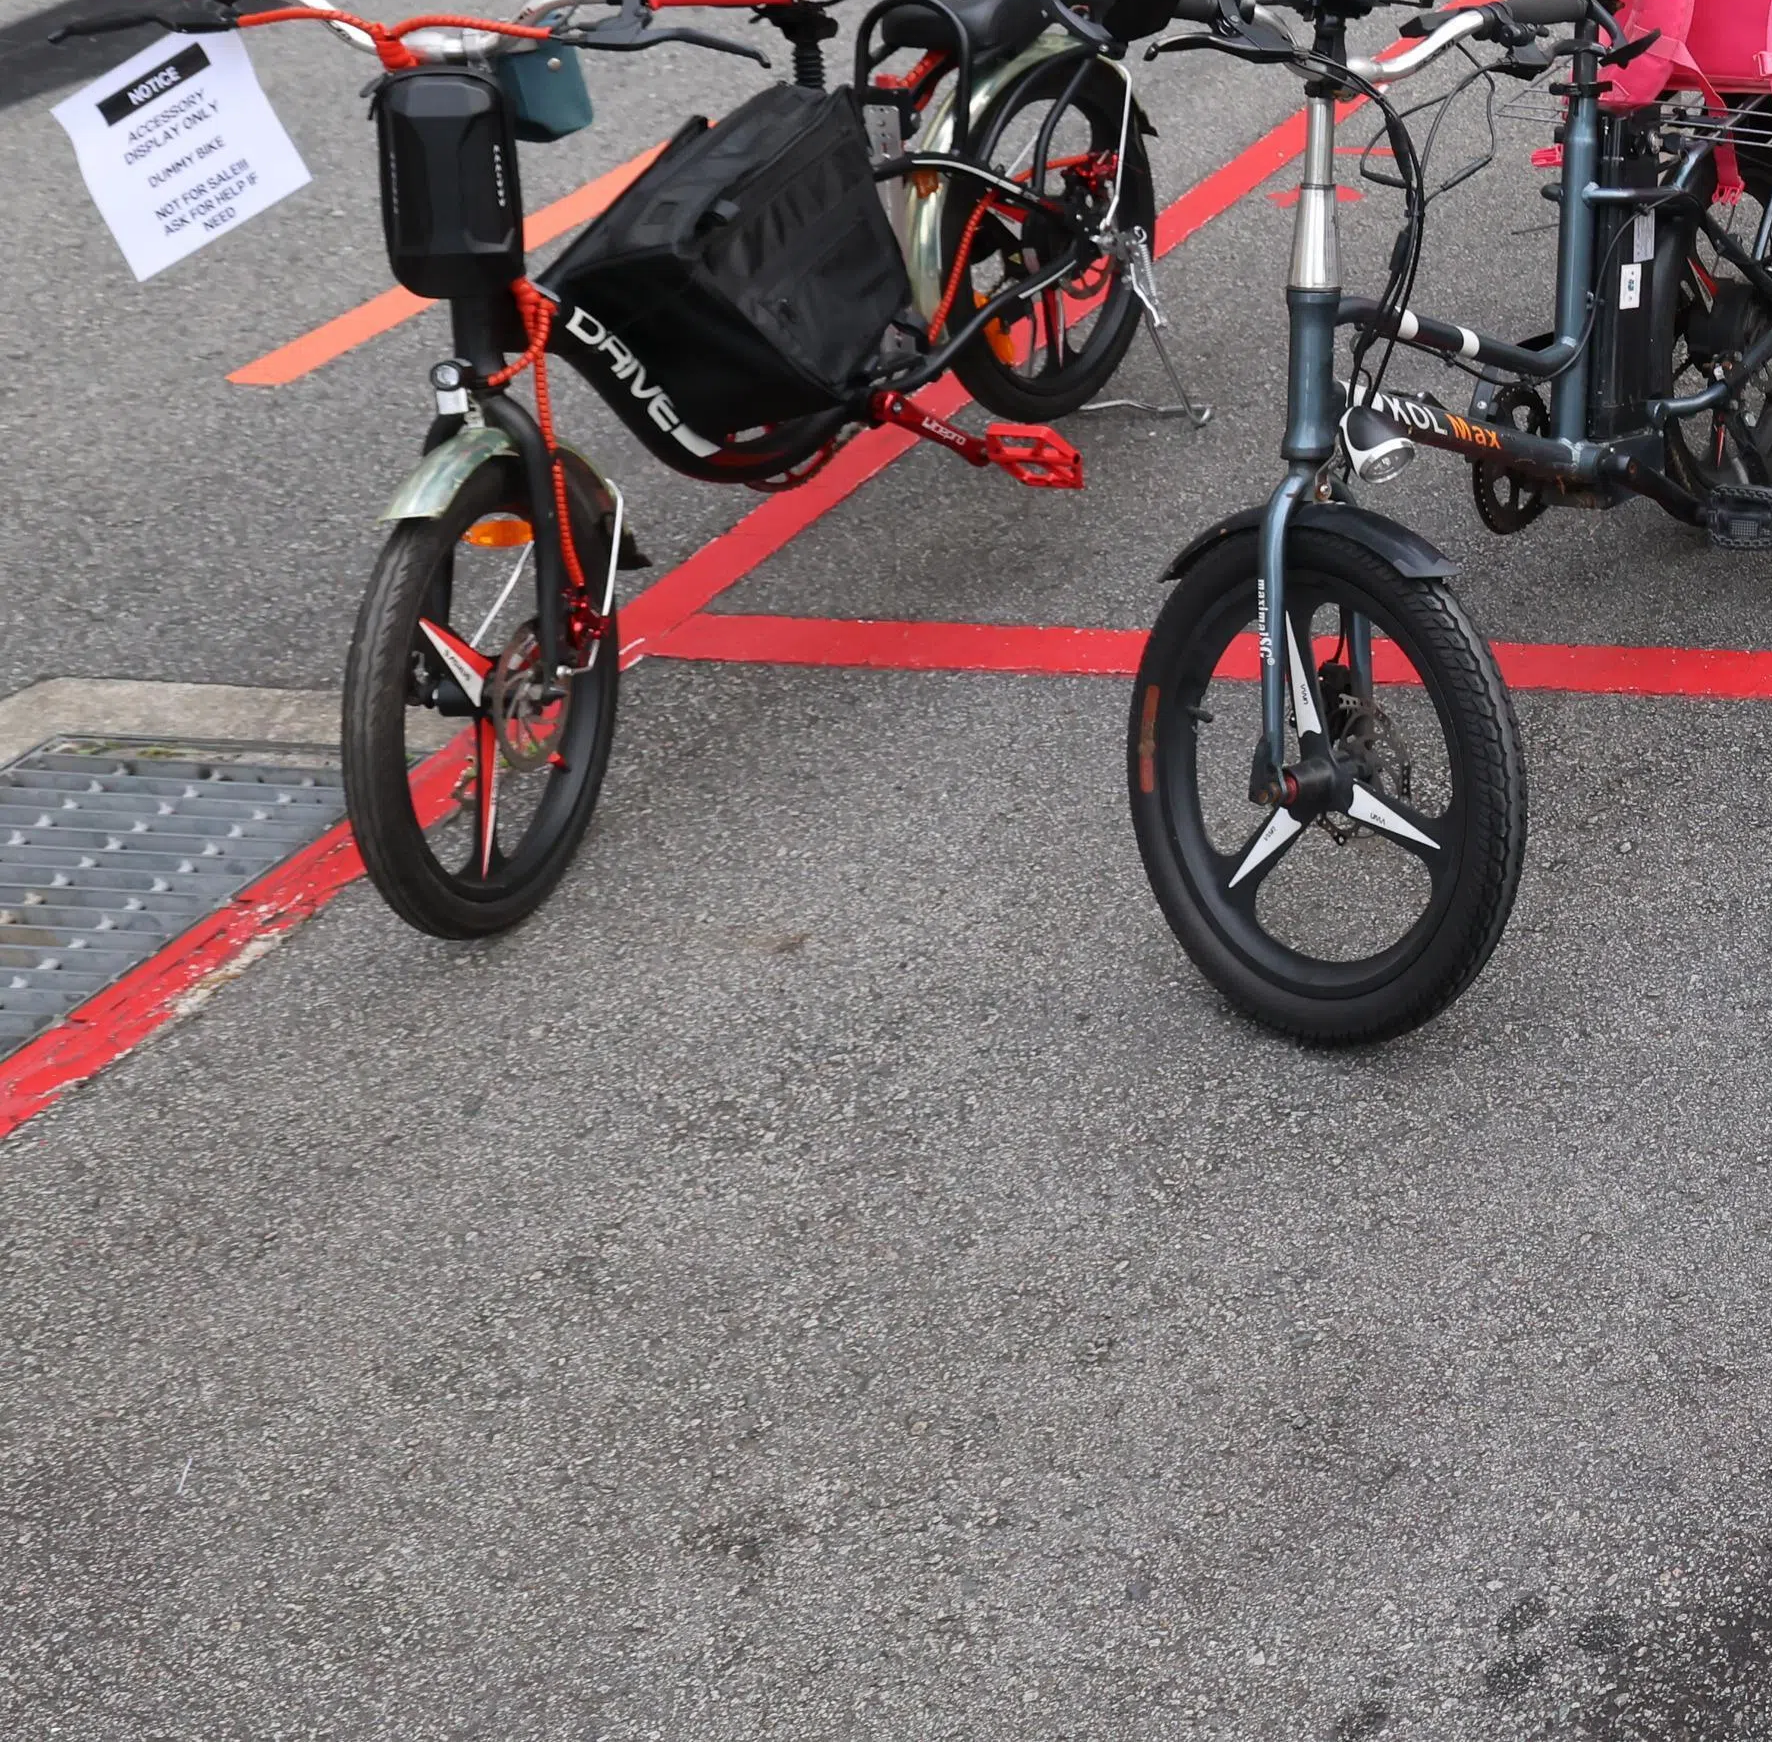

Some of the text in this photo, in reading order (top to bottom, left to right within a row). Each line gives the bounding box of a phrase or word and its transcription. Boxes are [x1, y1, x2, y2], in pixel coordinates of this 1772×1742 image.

[127, 66, 181, 106] NOTICE
[124, 99, 220, 165] DISPLAY ONLY
[128, 88, 205, 144] ACCESSORY
[148, 134, 226, 188] DUMMY BIKE
[155, 197, 183, 221] NOT
[182, 182, 208, 206] FOR
[164, 171, 260, 236] ASK FOR HELP IF
[203, 205, 236, 232] NEED
[565, 306, 682, 433] DRIVE
[1445, 412, 1502, 450] Max
